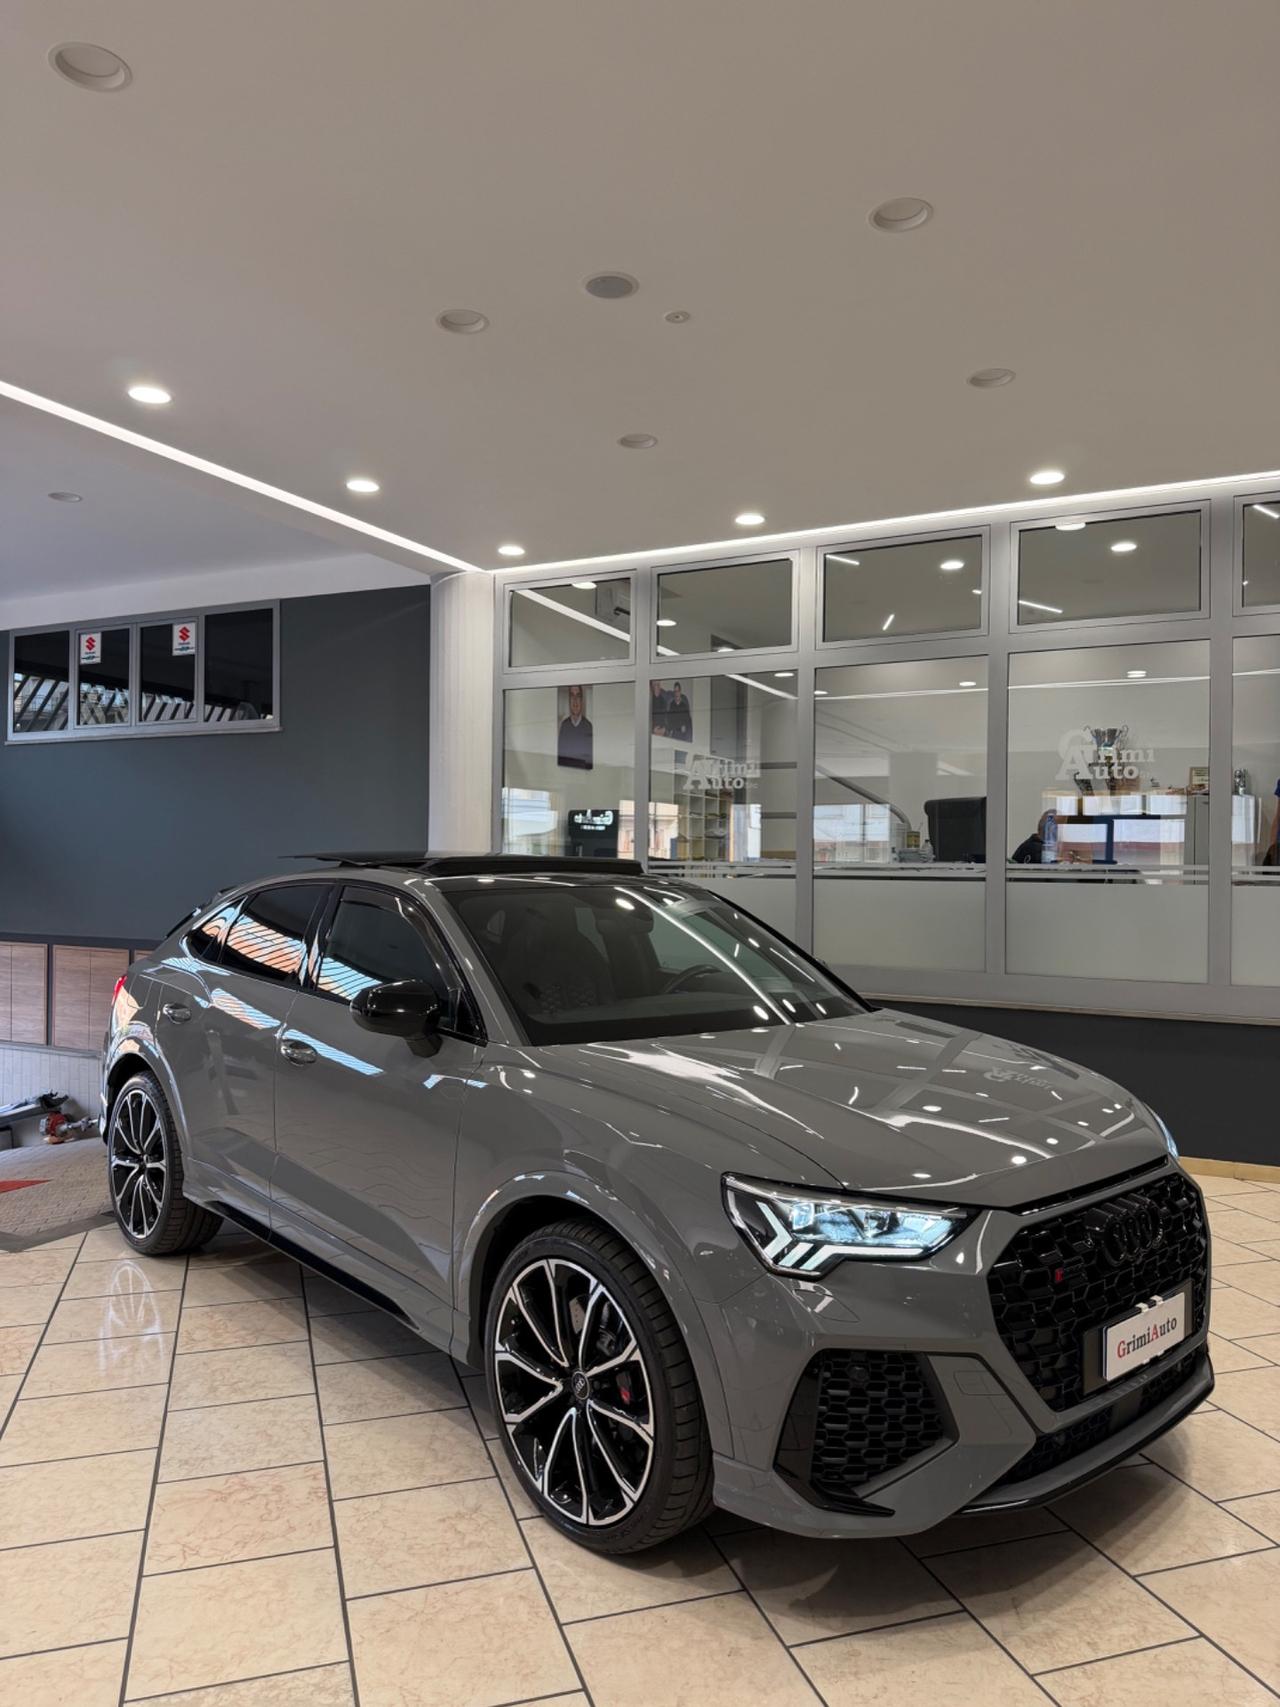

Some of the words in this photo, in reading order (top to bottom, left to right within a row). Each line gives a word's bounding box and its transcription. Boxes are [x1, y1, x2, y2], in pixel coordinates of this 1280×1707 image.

[683, 759, 745, 790] Auto
[1055, 745, 1139, 780] Auto
[1116, 1316, 1178, 1358] GrimiAuto
